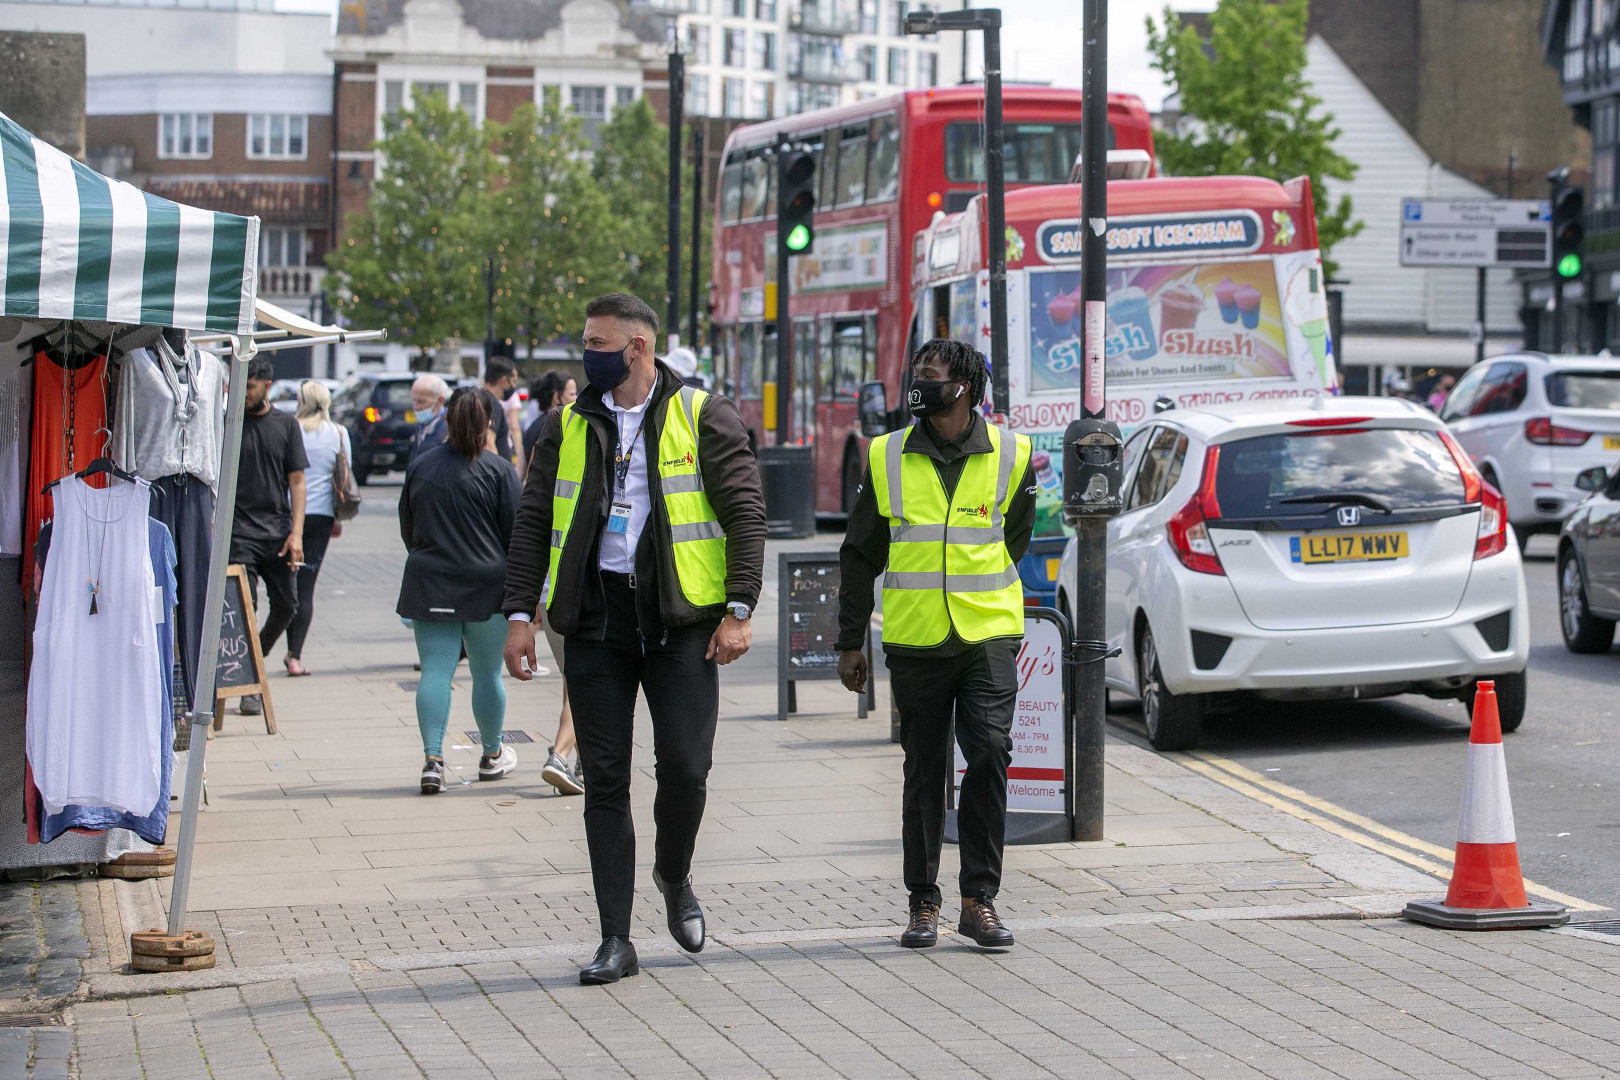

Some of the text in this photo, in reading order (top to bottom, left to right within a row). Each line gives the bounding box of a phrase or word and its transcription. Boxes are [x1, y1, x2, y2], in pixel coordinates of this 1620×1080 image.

[1050, 220, 1247, 253] SA SOFT ICECREAM
[1050, 324, 1149, 372] Slsh
[1163, 329, 1255, 358] Slush
[1151, 366, 1179, 376] Shows
[1180, 364, 1197, 374] And
[1198, 363, 1226, 373] Events
[1009, 398, 1147, 429] SLOW IND
[1309, 534, 1401, 558] LL17 WWV
[219, 634, 249, 658] RUS
[1018, 701, 1059, 712] BEAUTY
[1018, 715, 1041, 726] 5241
[1033, 732, 1049, 741] 7PM
[1018, 745, 1033, 754] 6.30
[1035, 745, 1047, 754] PM
[1008, 784, 1055, 797] Welcome
